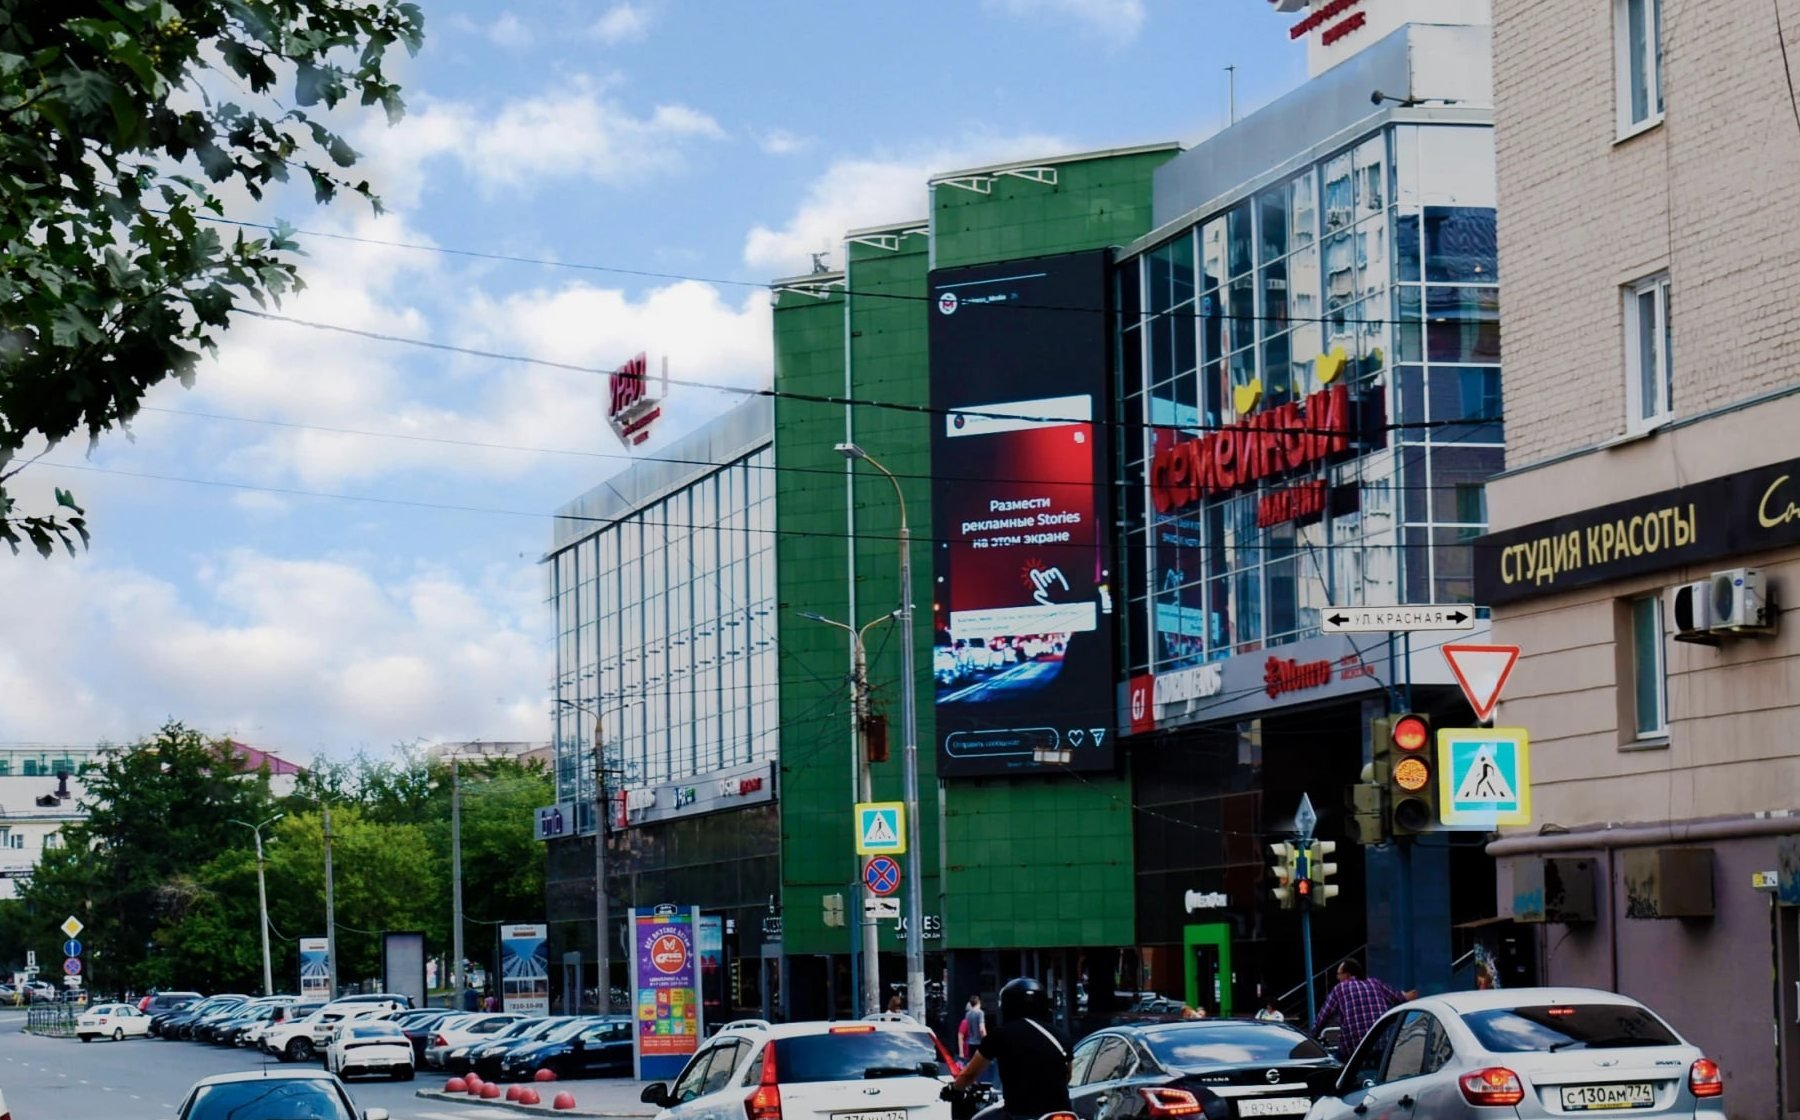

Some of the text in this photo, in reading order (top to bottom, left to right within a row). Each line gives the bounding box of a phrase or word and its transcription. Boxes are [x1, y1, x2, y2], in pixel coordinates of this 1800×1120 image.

[990, 498, 1051, 512] Размести
[962, 511, 1081, 535] рекламные Stories
[973, 531, 1070, 549] на этом экране
[1501, 503, 1696, 586] СТУДИЯ КРАСОТЫ
[1355, 612, 1443, 626] УЛ КРАСНАЯ
[1132, 688, 1146, 721] GJ
[894, 914, 941, 932] JES
[1566, 1084, 1651, 1104] С130АМ 774
